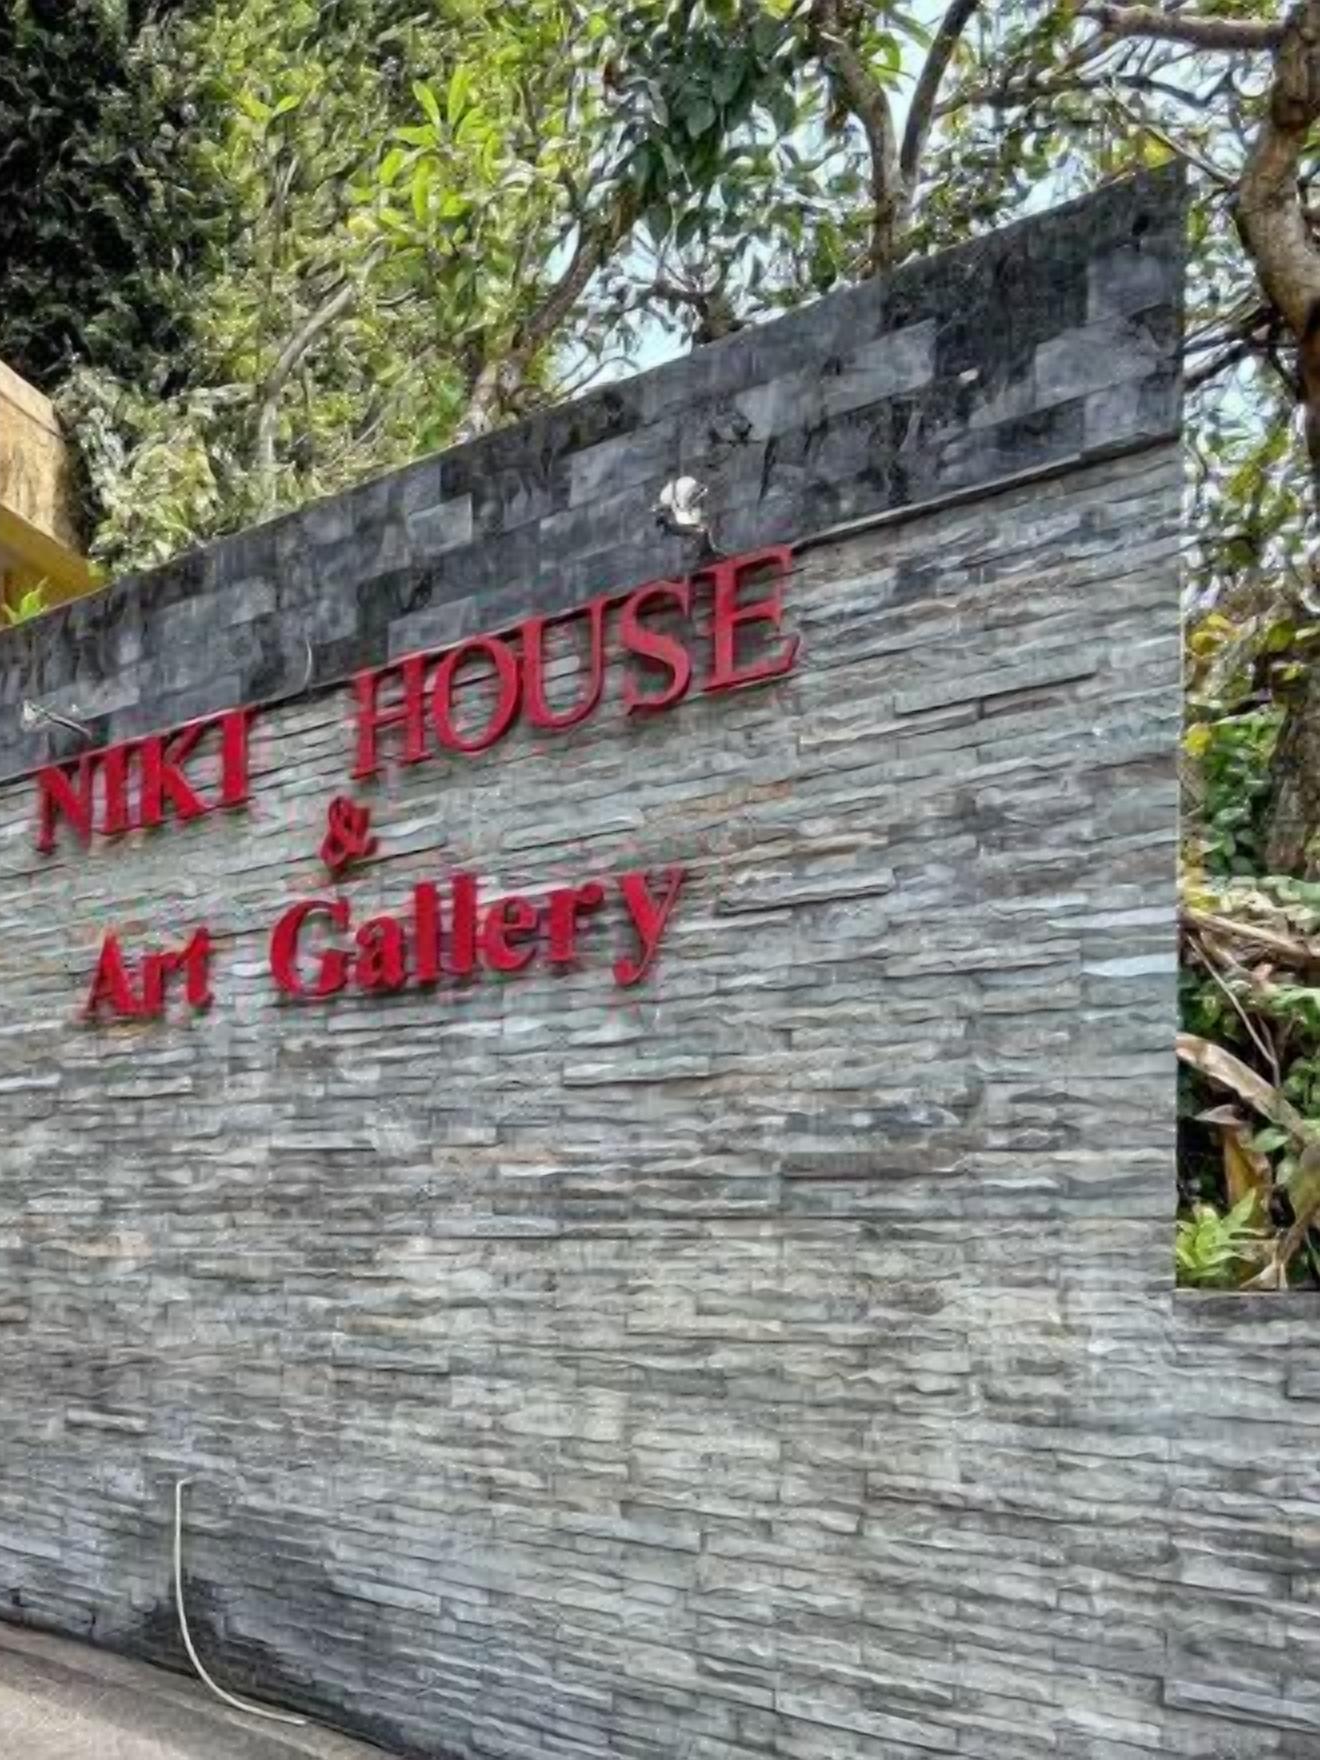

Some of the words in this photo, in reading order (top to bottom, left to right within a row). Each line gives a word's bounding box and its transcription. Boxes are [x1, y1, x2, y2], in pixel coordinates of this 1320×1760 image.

[32, 703, 260, 854] NIKI
[348, 544, 801, 780] HOUSE
[318, 796, 378, 876] &
[85, 925, 214, 1020] Art
[269, 867, 684, 998] Gallery
